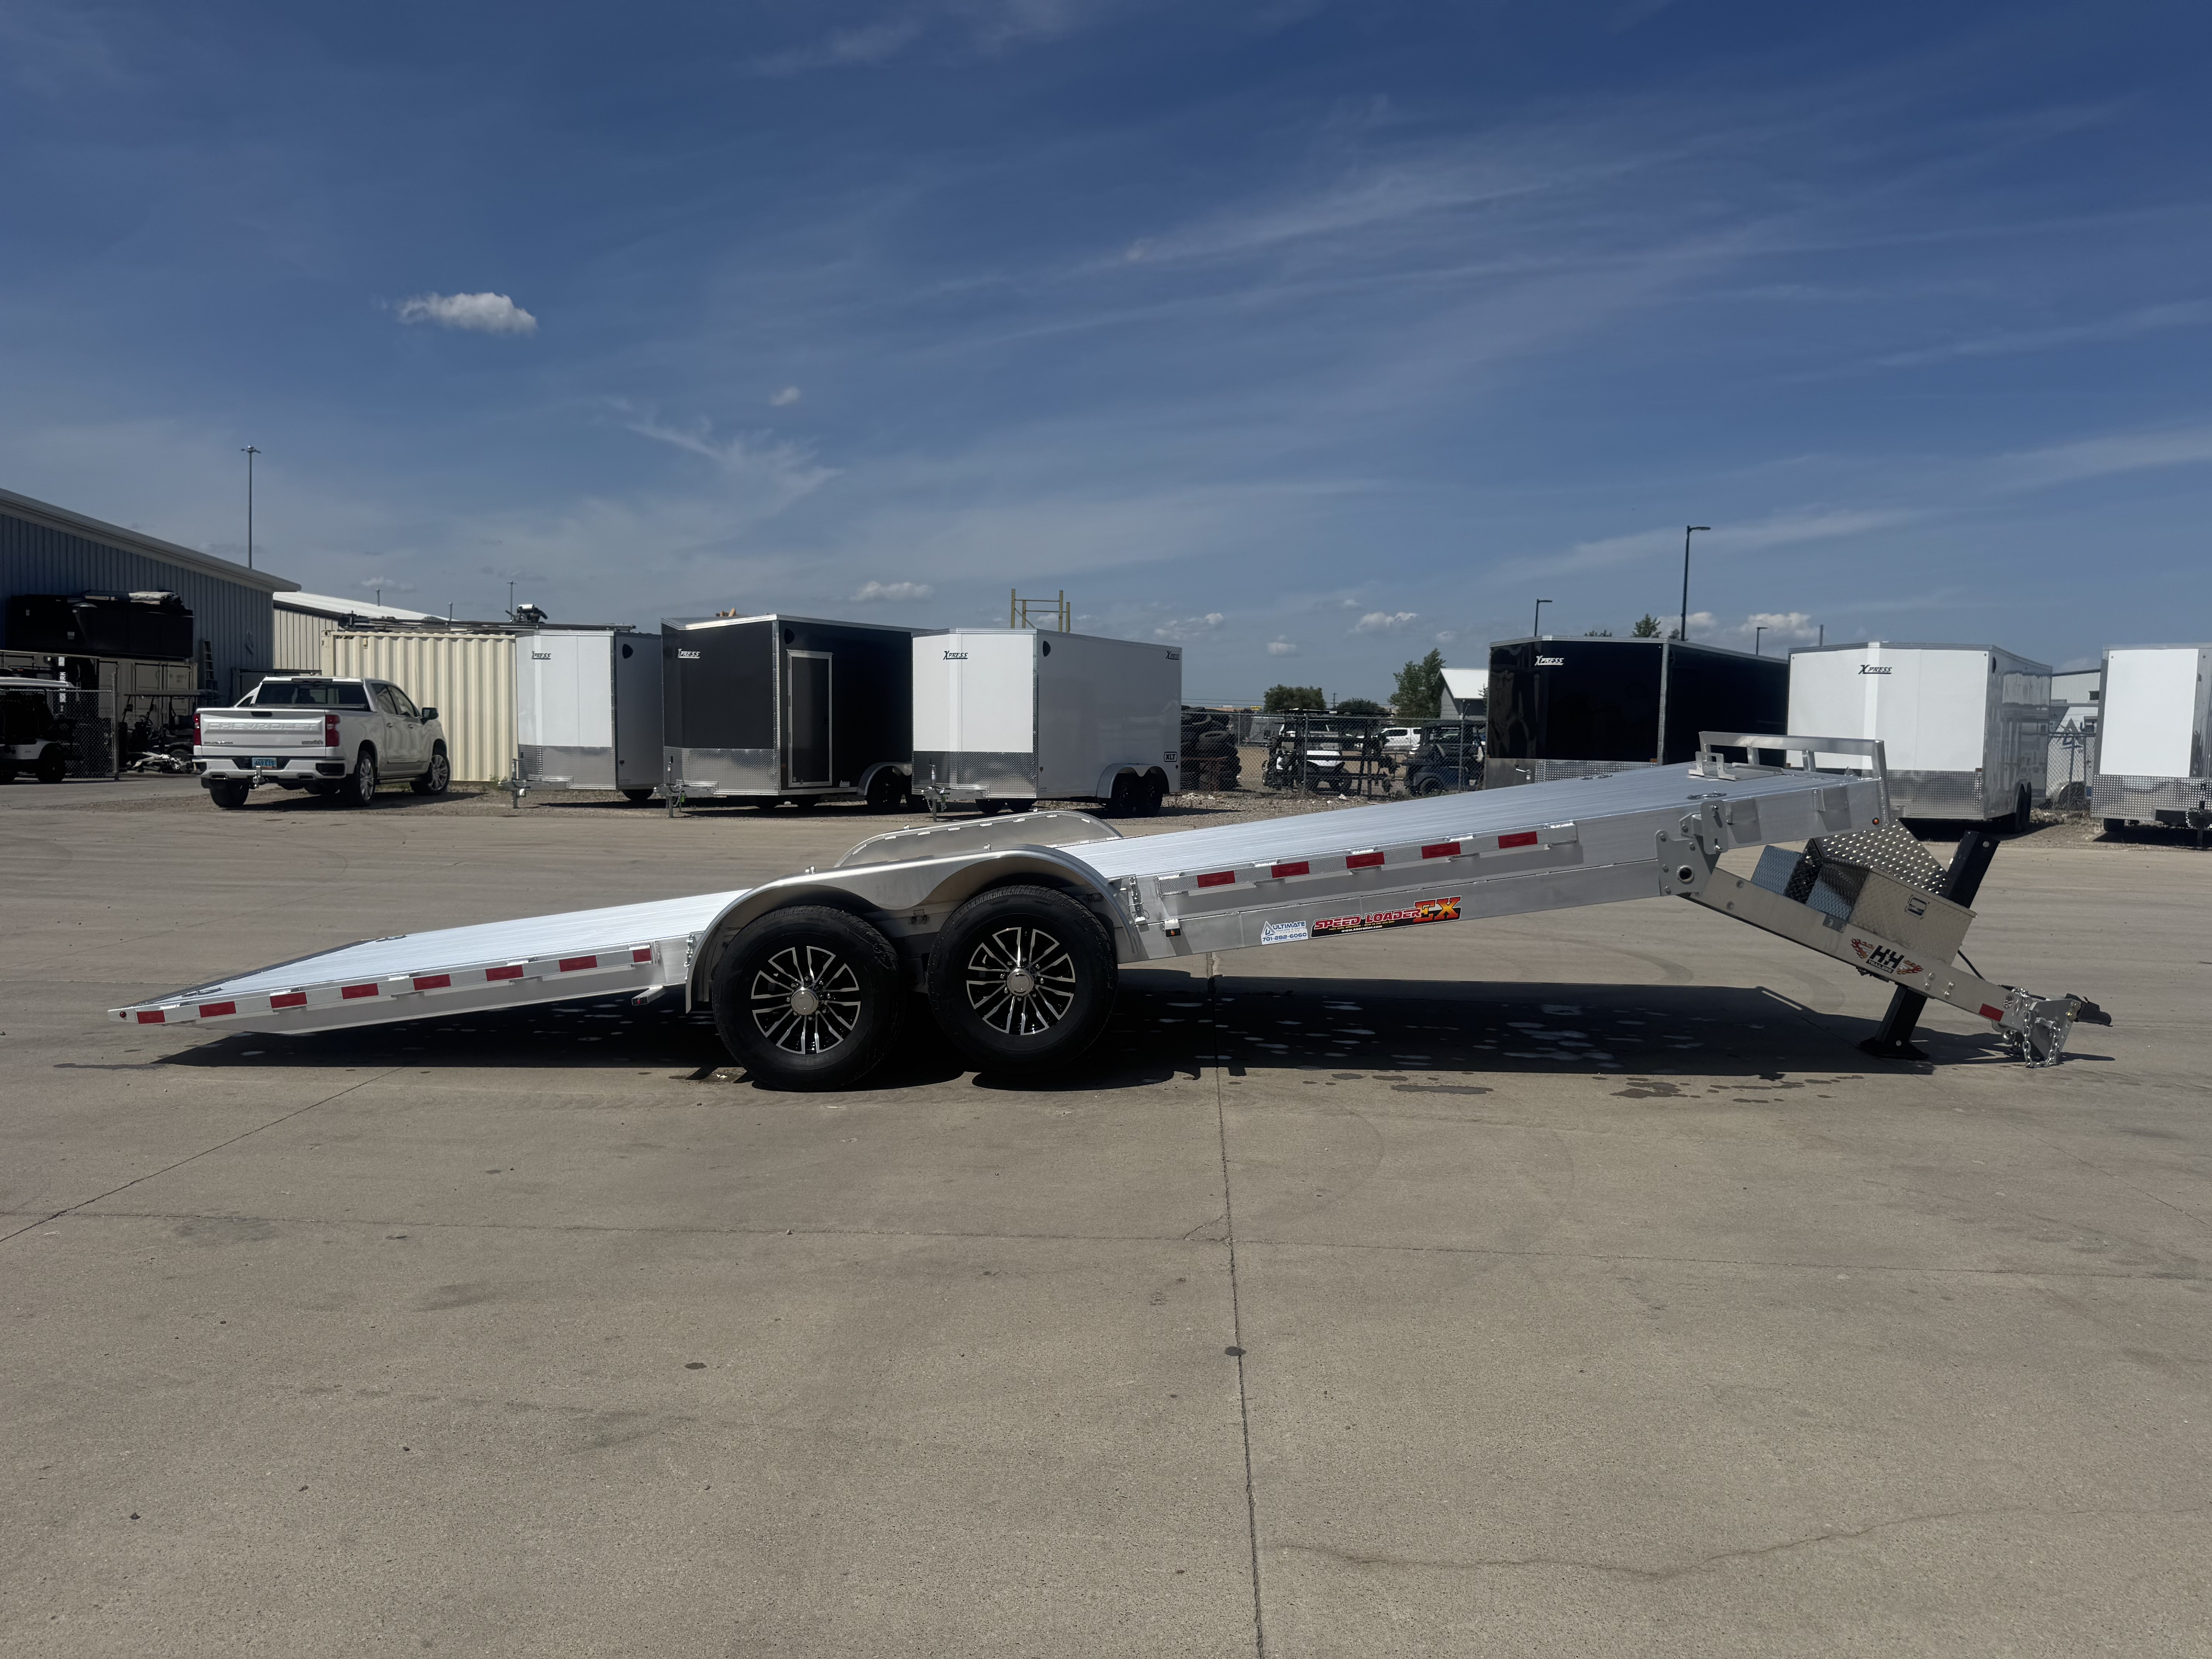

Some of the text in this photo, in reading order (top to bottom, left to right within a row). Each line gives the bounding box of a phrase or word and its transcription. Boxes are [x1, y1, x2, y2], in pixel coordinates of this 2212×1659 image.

[943, 651, 969, 660] XPRESS
[1534, 655, 1565, 666] XPRESS
[1858, 665, 1892, 674] XPRESS
[1314, 915, 1361, 929] SPEED
[1365, 908, 1422, 924] LOADER
[1262, 933, 1307, 941] 701-282-6060
[1868, 960, 1893, 973] TRAILERS
